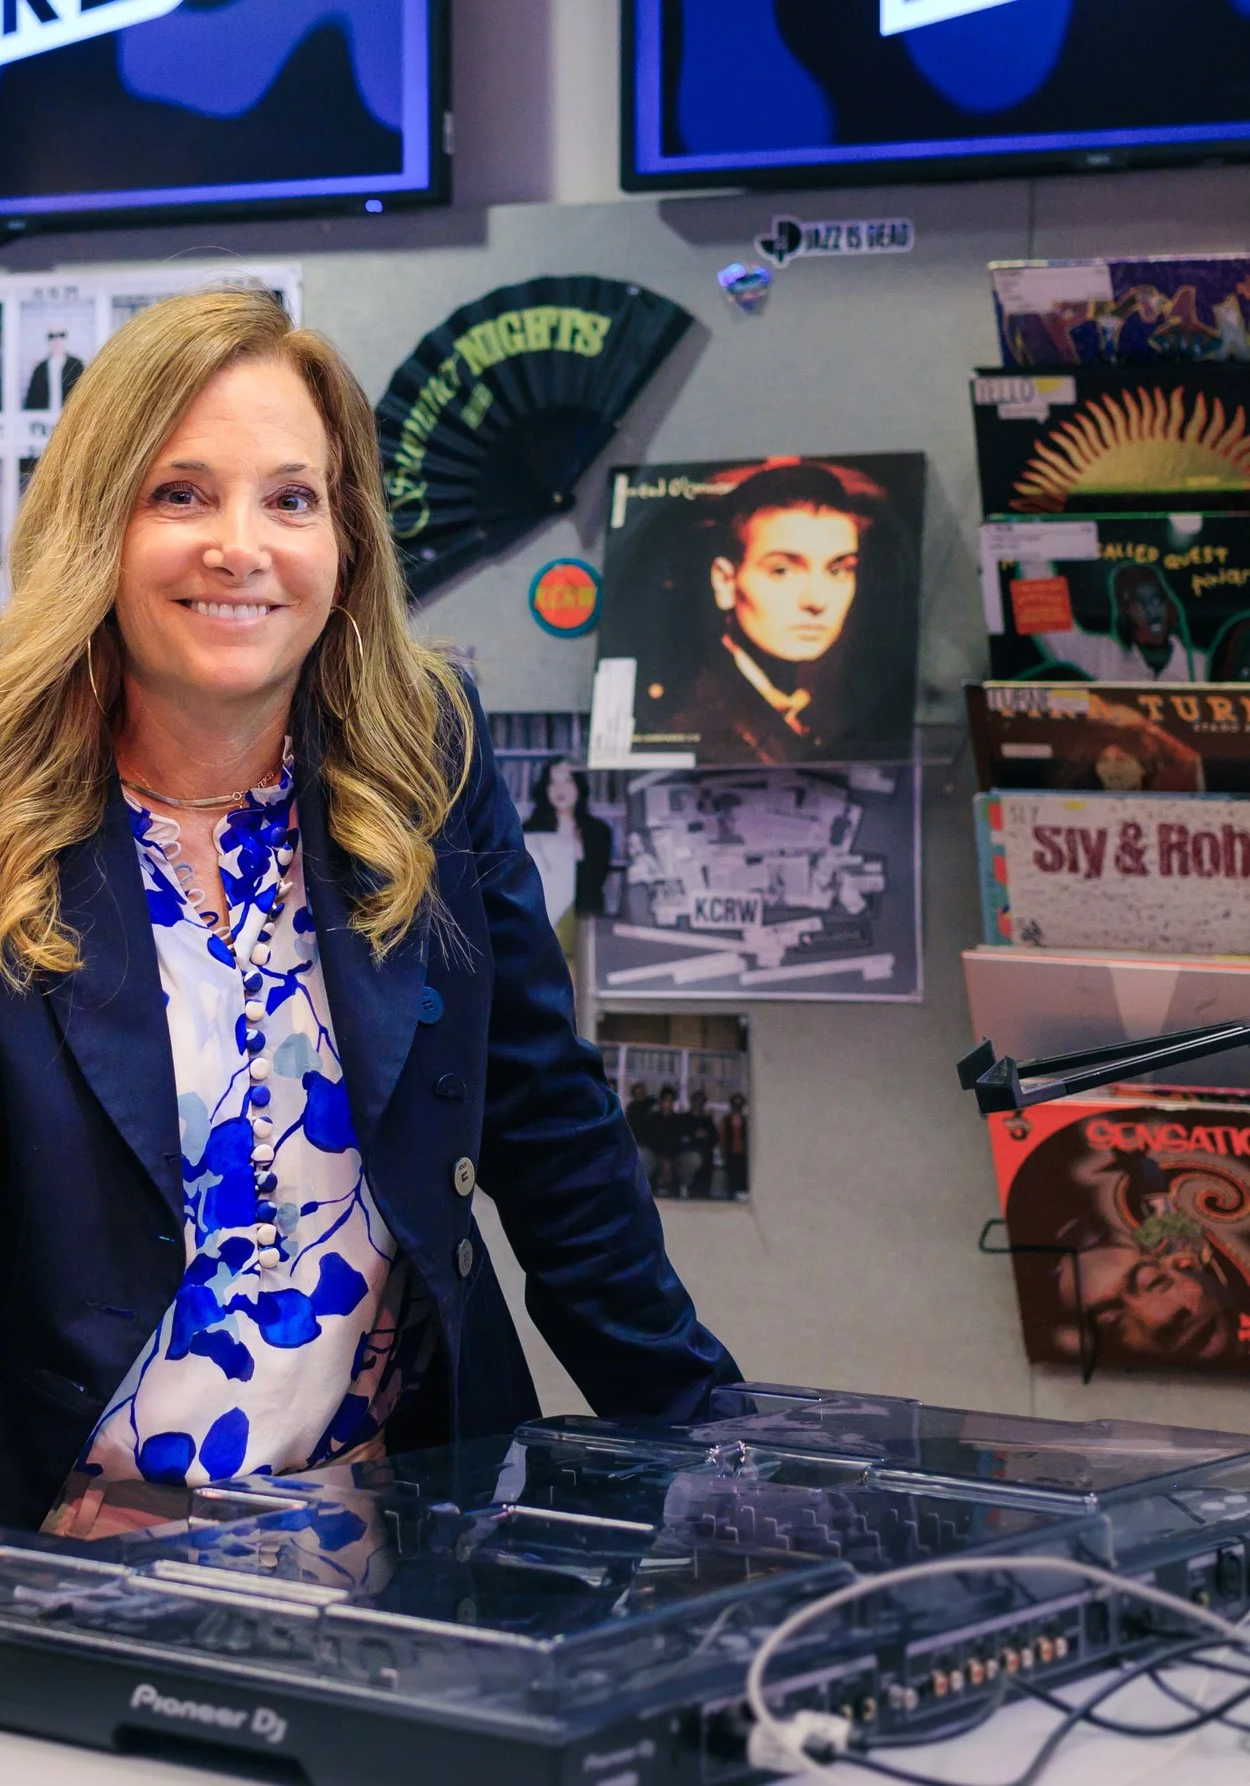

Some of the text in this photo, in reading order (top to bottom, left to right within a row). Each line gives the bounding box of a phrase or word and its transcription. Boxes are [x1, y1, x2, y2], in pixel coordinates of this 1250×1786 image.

[453, 304, 613, 377] NIGHTS
[1113, 820, 1149, 877] &
[695, 897, 758, 923] KCRW
[130, 1683, 248, 1729] Pioneer
